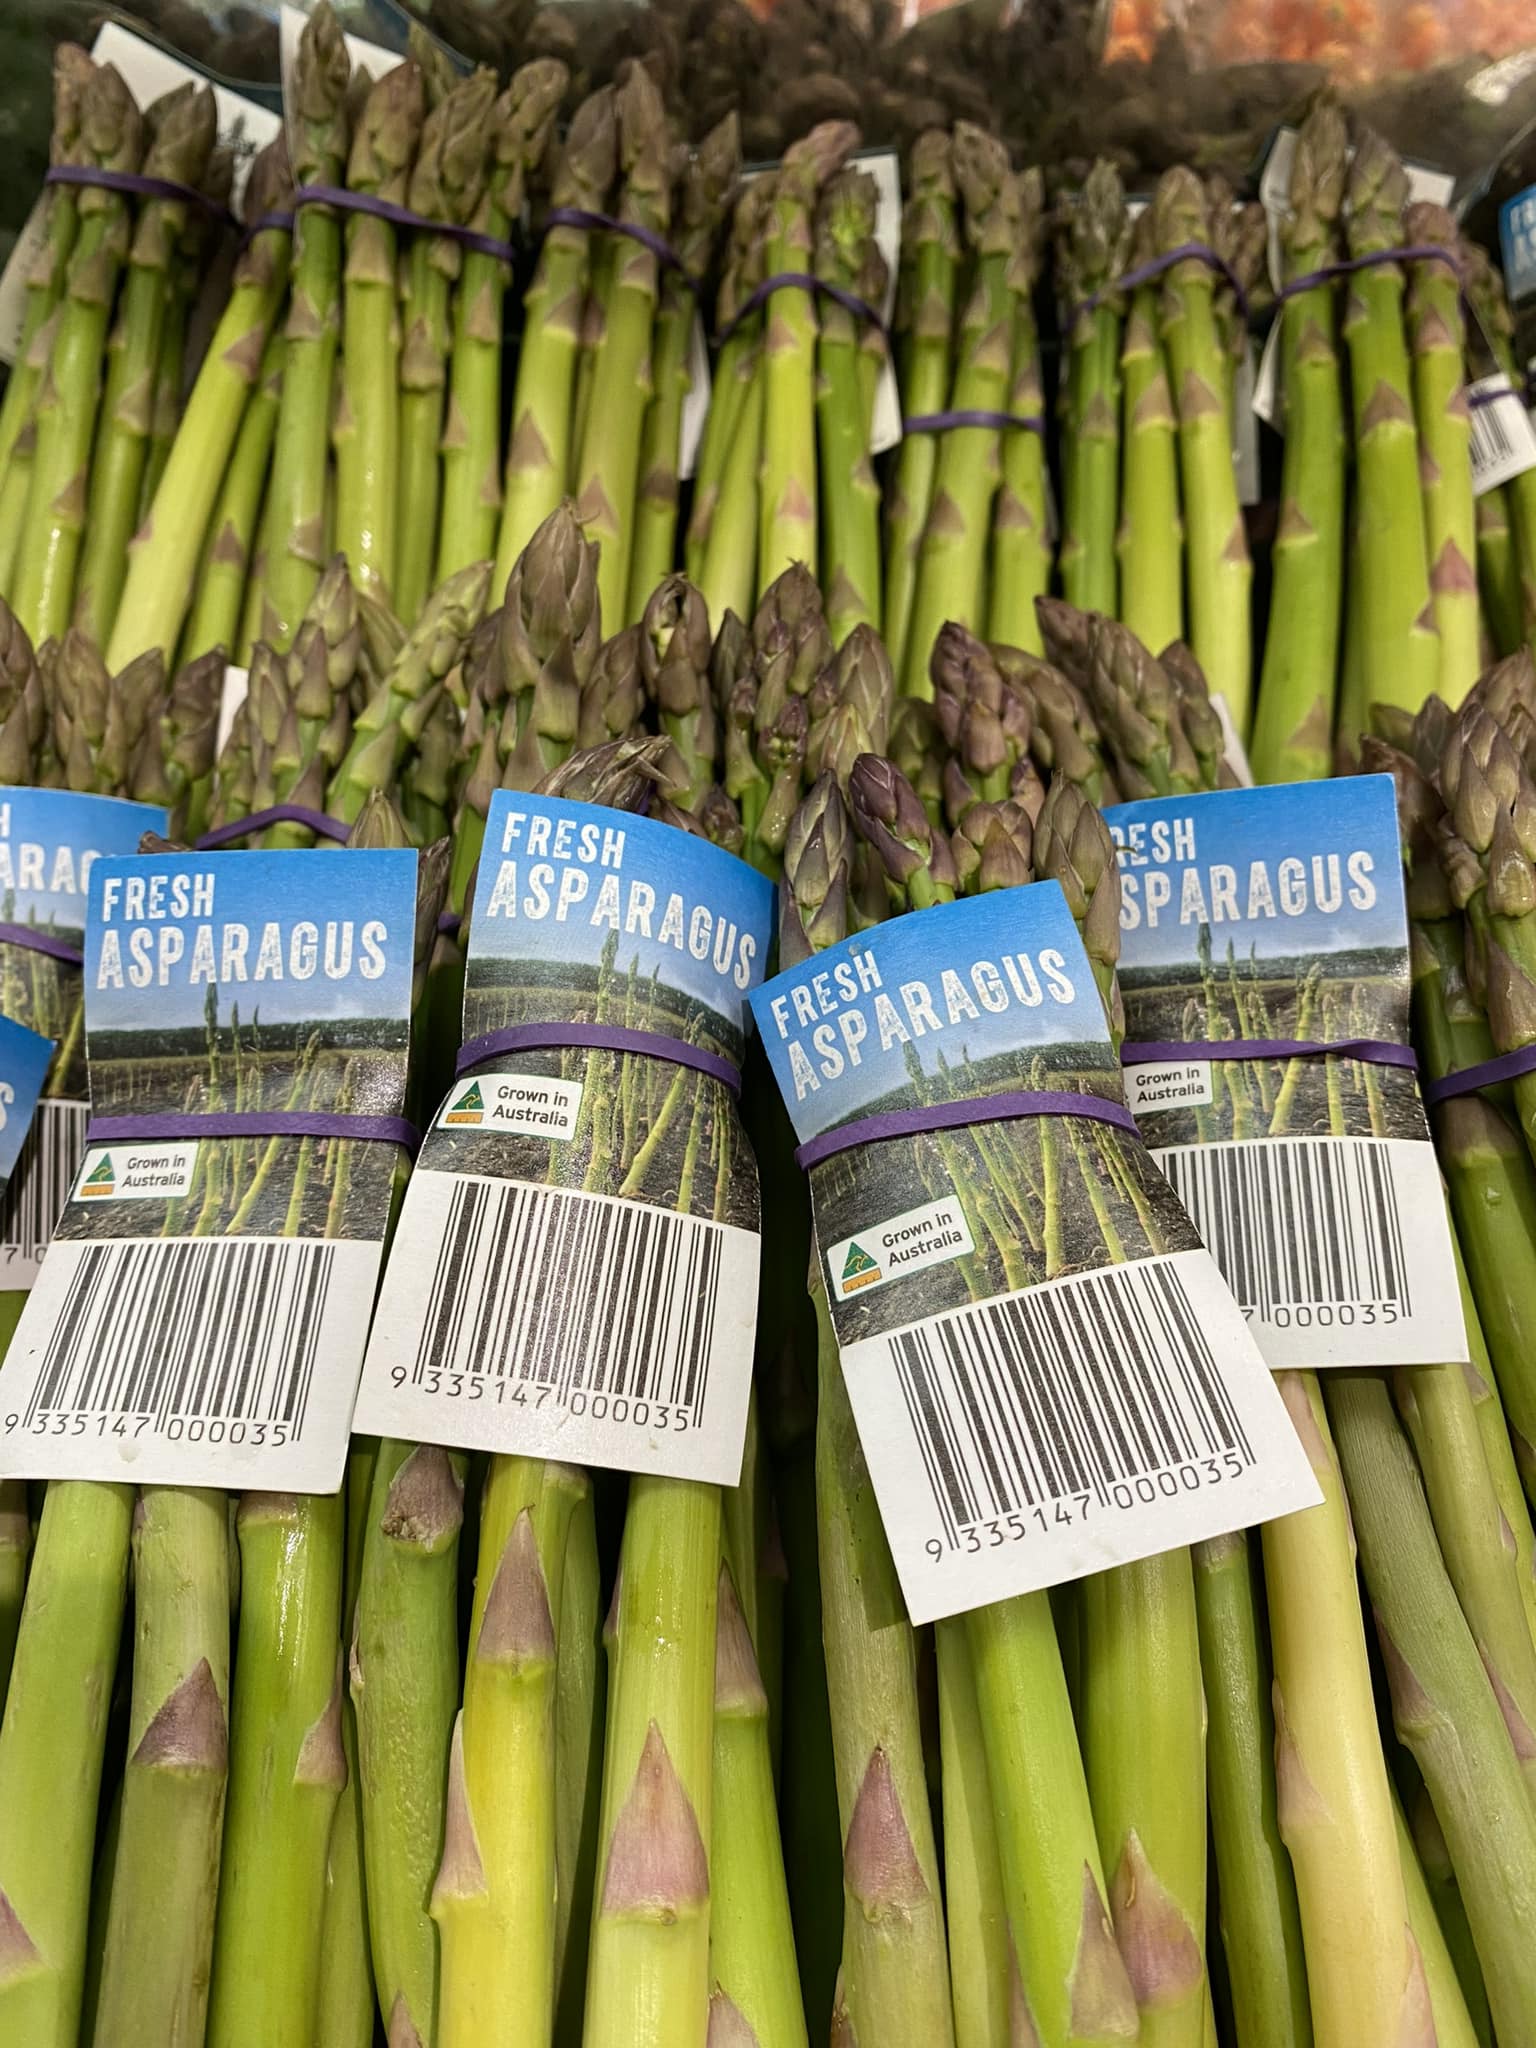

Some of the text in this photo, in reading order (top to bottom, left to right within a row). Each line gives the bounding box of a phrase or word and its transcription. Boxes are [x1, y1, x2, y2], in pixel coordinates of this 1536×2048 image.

[501, 812, 625, 869] FRESH
[1110, 818, 1196, 867] RESH
[101, 873, 215, 922] FRESH
[1119, 851, 1377, 930] SPARAGUS
[487, 860, 756, 990] ASPARAGUS
[96, 921, 388, 989] ASPARAGUS
[770, 950, 883, 1039] FRESH
[787, 949, 1076, 1101] ASPARAGUS
[498, 1085, 568, 1107] Grown in
[1136, 1067, 1200, 1086] Grown in
[1137, 1083, 1205, 1103] Australia
[492, 1104, 568, 1127] Australia
[121, 1172, 185, 1188] Australia
[127, 1154, 186, 1170] Grown in
[882, 1212, 953, 1248] Grown in
[889, 1230, 963, 1267] Australia
[1275, 1304, 1398, 1328] 000035
[390, 1366, 690, 1432] 9 335147 000035
[5, 1413, 288, 1447] 9 335147 000035
[925, 1452, 1244, 1563] 9 335147 000035
